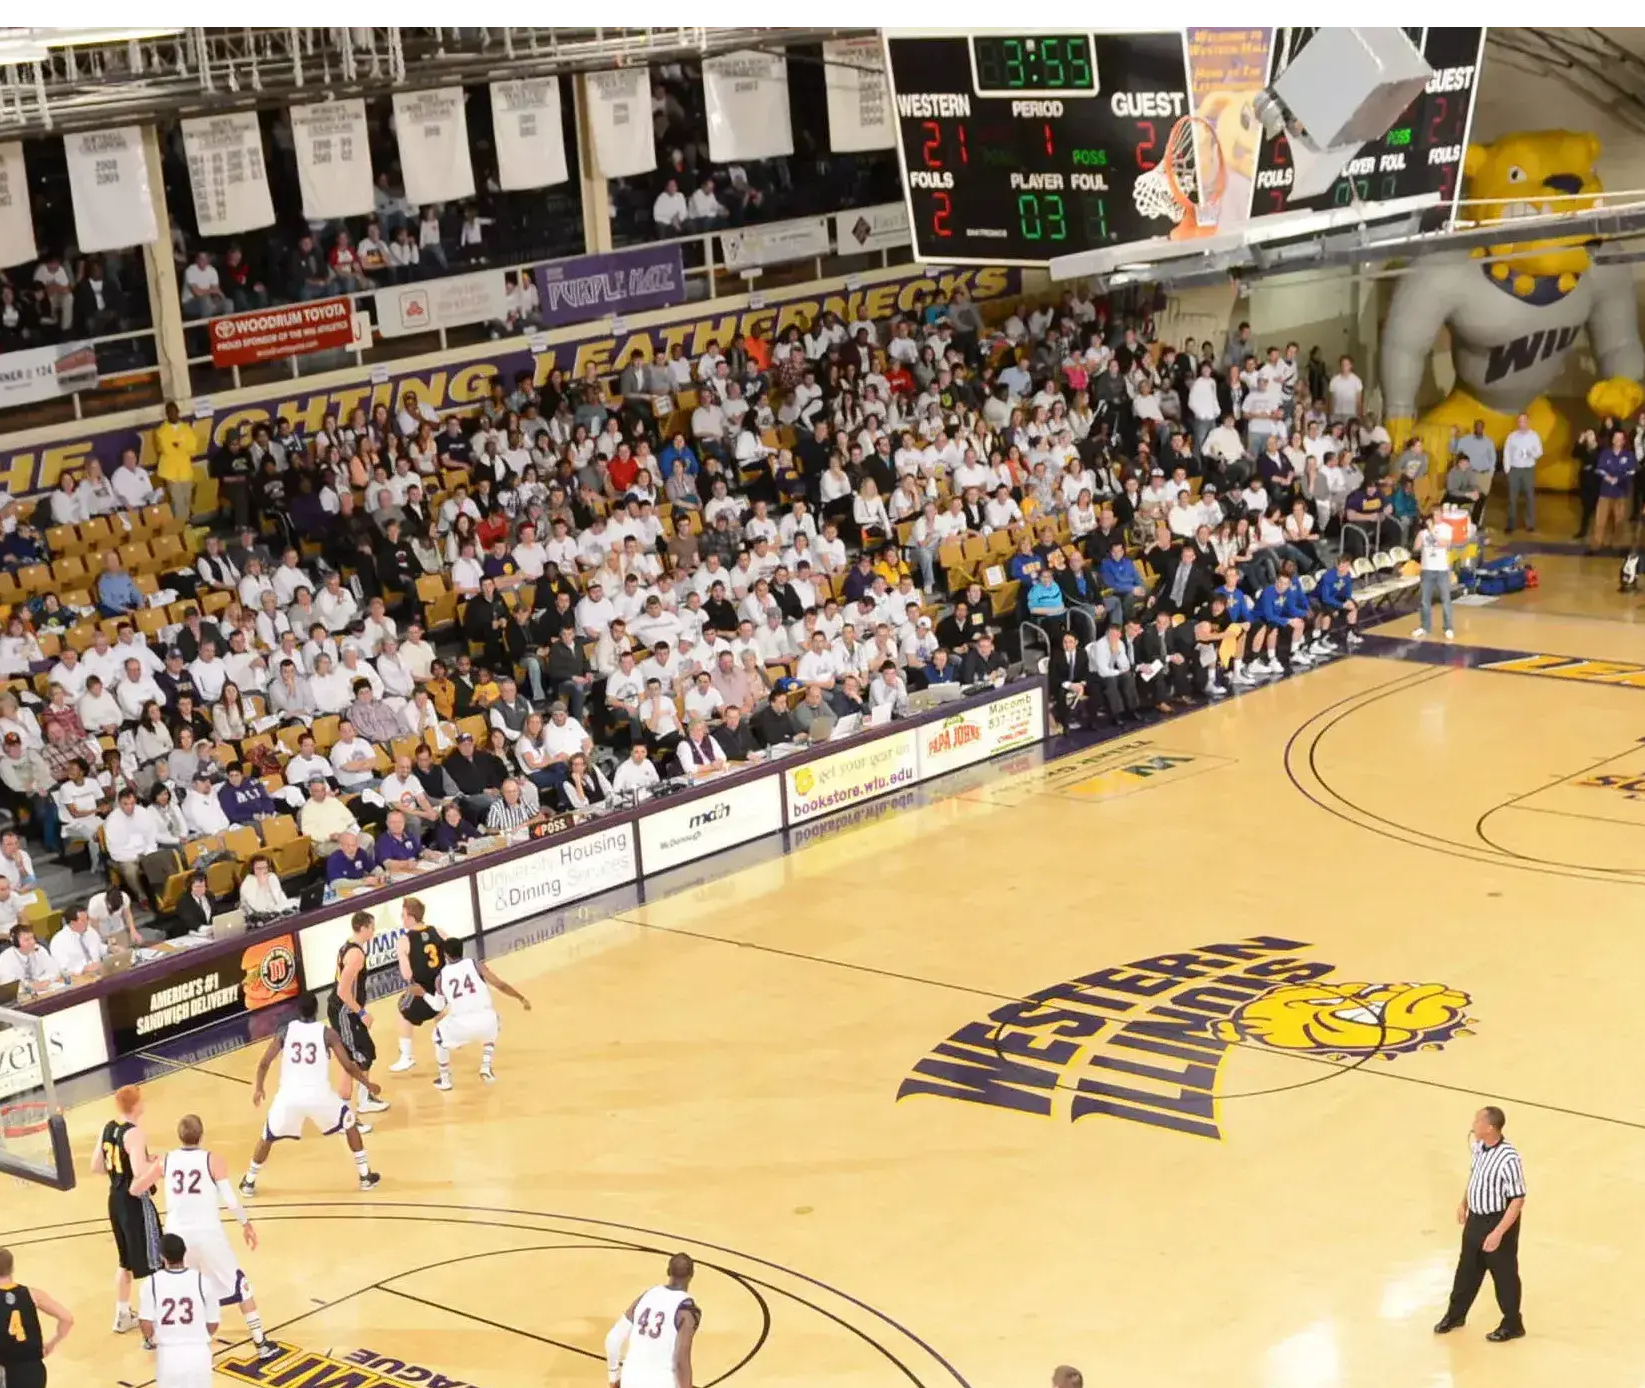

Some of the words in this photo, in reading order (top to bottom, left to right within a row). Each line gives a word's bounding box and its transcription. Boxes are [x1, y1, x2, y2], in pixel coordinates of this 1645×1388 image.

[1004, 39, 1090, 87] 3:55
[1425, 66, 1474, 93] GUEST
[898, 92, 971, 118] WESTERN
[1012, 100, 1064, 118] PERIOD
[1111, 92, 1185, 117] GUEST
[921, 121, 968, 167] 21
[1071, 148, 1107, 166] POSS
[1428, 147, 1460, 166] FOULS
[1379, 154, 1406, 172] FOUL
[910, 171, 954, 190] FOULS
[1010, 173, 1064, 191] PLAYER
[1071, 173, 1109, 192] FOUL
[1257, 168, 1294, 190] FOULS
[932, 191, 953, 237] 2
[235, 310, 303, 334] WOODRUM
[305, 303, 346, 322] TOYOTA
[534, 266, 1008, 388] LEATHERNECKS
[1485, 327, 1584, 384] WIU
[35, 362, 53, 378] 124
[926, 730, 951, 757] PAPA
[559, 829, 628, 866] Housing
[423, 944, 438, 969] 3
[150, 977, 203, 1012] AMERICA'S
[448, 972, 477, 999] 24
[136, 1004, 190, 1036] SANDWICH
[190, 983, 240, 1018] DELIVERY!
[895, 934, 1315, 1118] WESTERN
[290, 1041, 318, 1066] 33
[1070, 956, 1339, 1142] ILLINOIS
[170, 1168, 203, 1196] 32
[160, 1296, 195, 1326] 23
[637, 1307, 666, 1340] 43
[8, 1309, 27, 1342] 4
